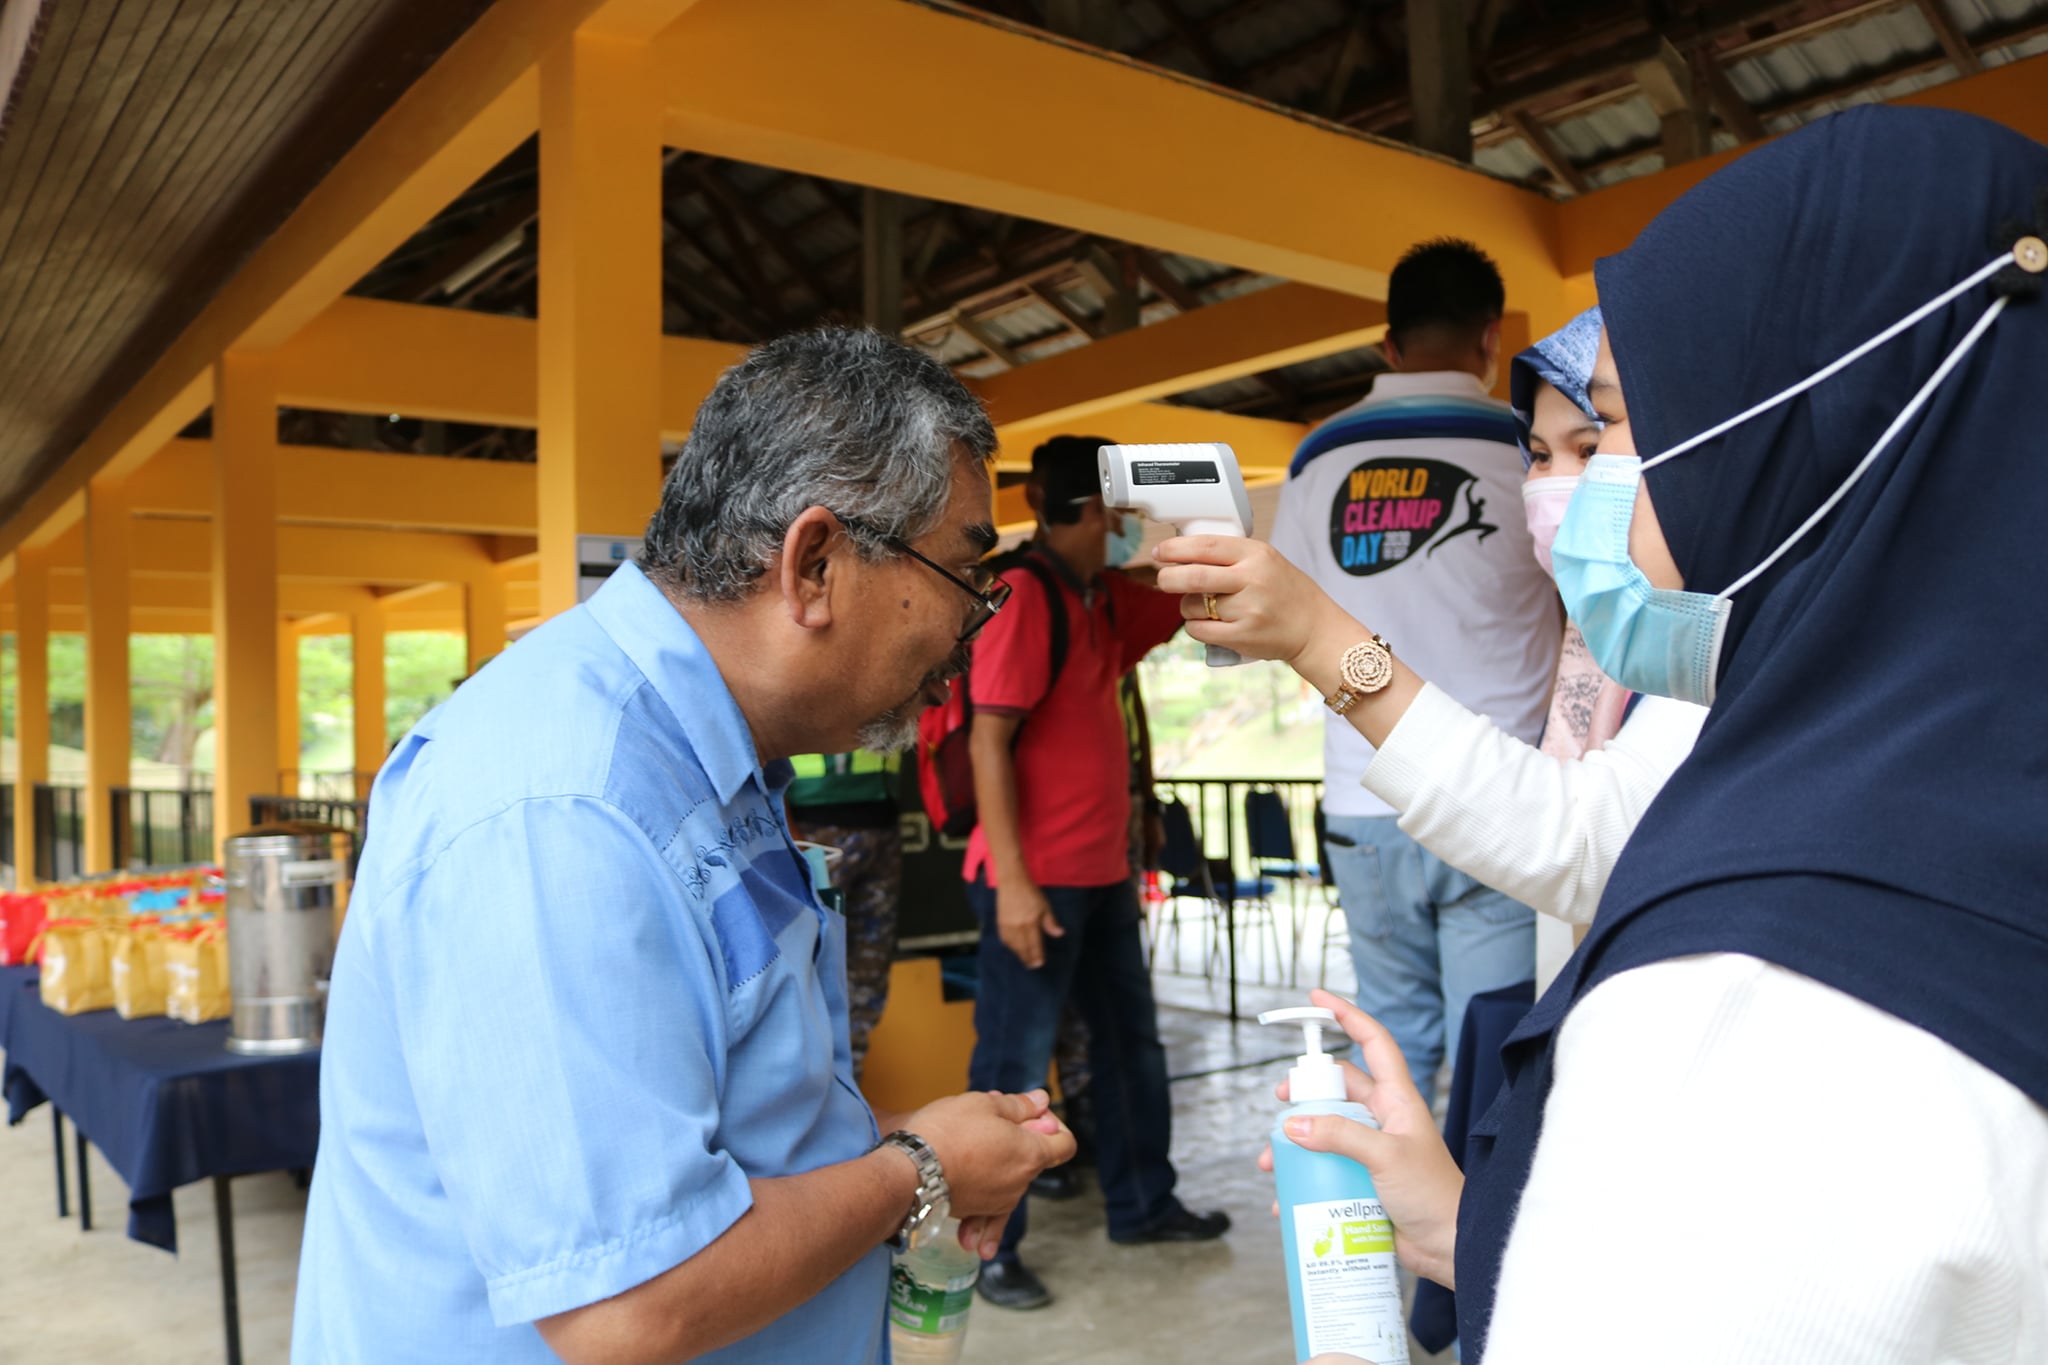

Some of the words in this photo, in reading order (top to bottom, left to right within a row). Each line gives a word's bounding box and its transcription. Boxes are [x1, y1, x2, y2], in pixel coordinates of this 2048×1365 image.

[1349, 468, 1429, 499] WORLD
[1343, 499, 1442, 534] CLEANUP
[1342, 532, 1383, 568] DAY
